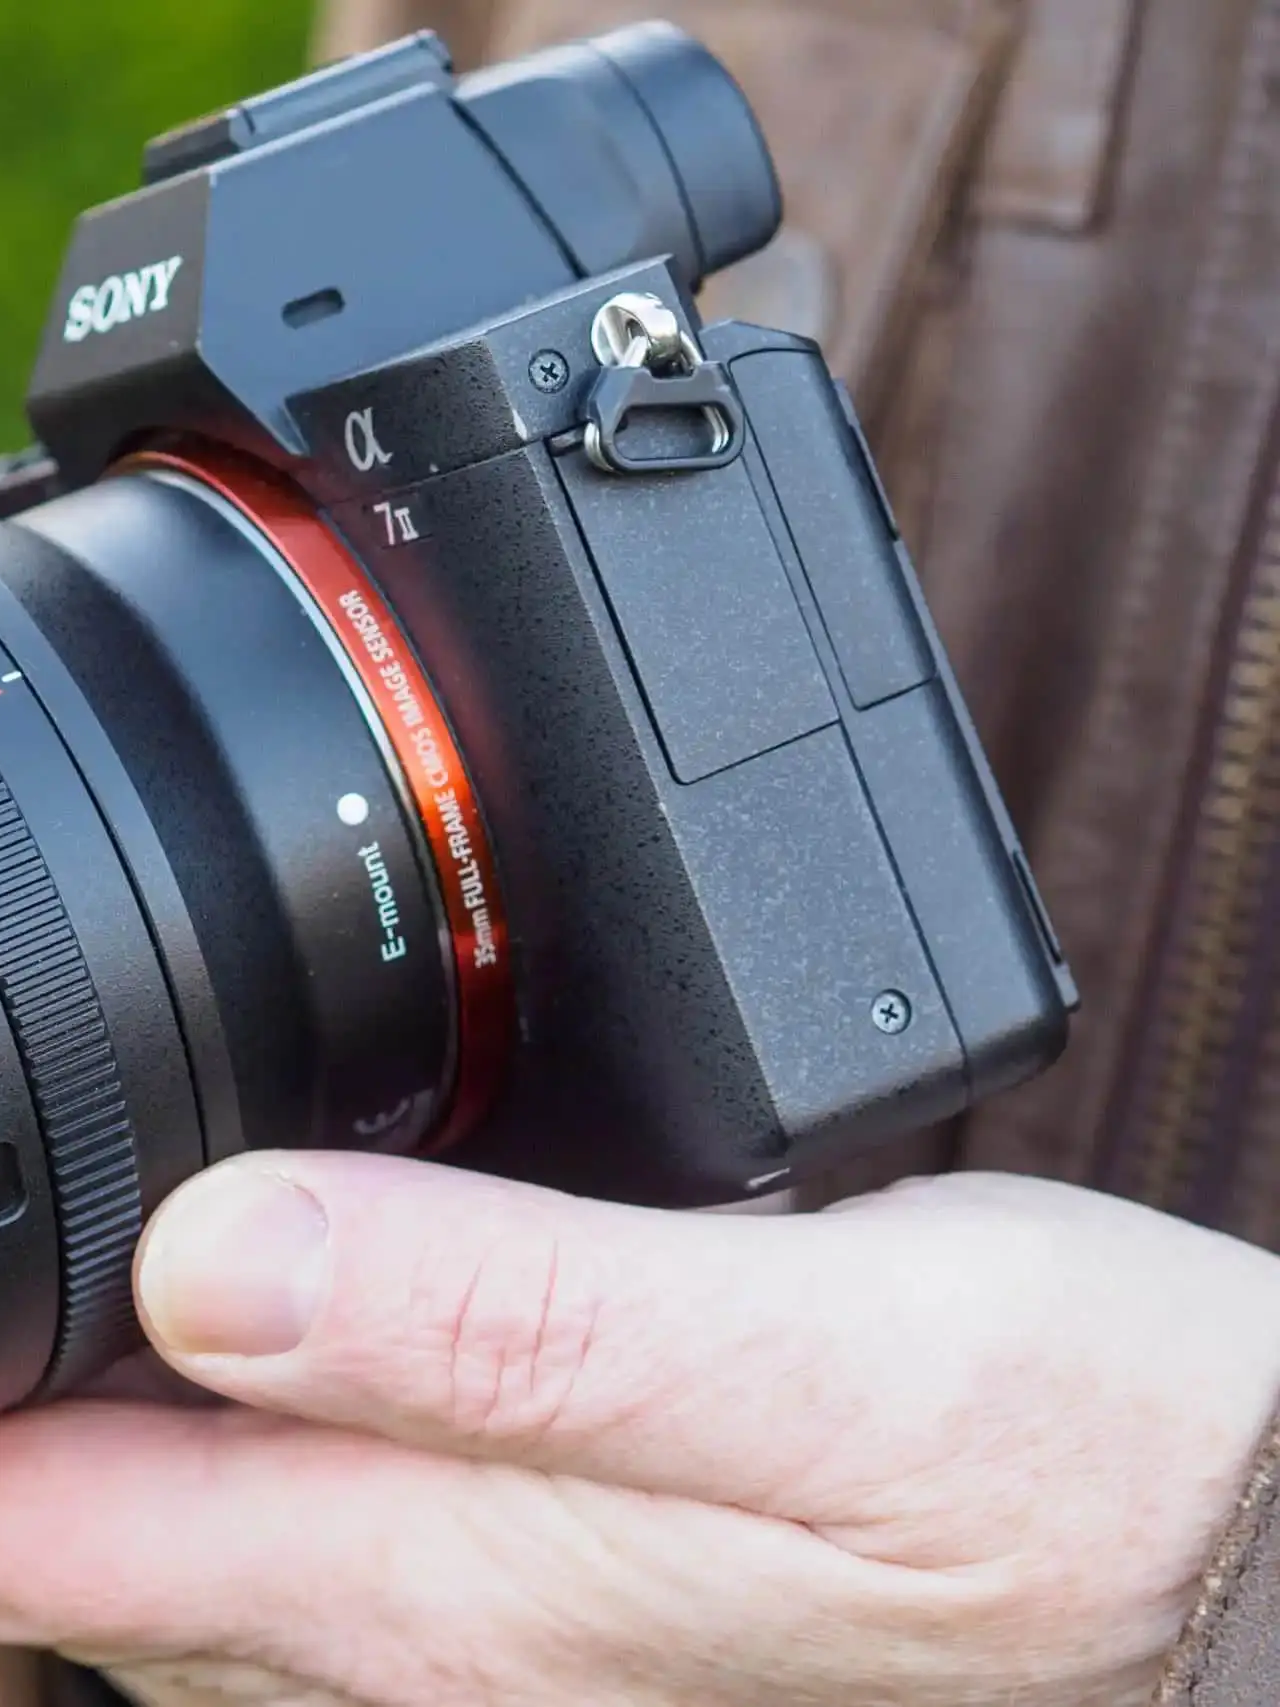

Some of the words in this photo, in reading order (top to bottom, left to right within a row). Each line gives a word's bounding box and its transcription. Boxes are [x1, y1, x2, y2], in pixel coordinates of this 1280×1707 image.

[63, 255, 183, 342] SONY
[338, 589, 394, 663] SENSOR
[379, 659, 424, 728] IMAGE
[410, 727, 449, 788] CMOS
[433, 787, 486, 909] FULL-FRAME
[357, 840, 407, 962] E-mount
[473, 906, 497, 969] 35mm
